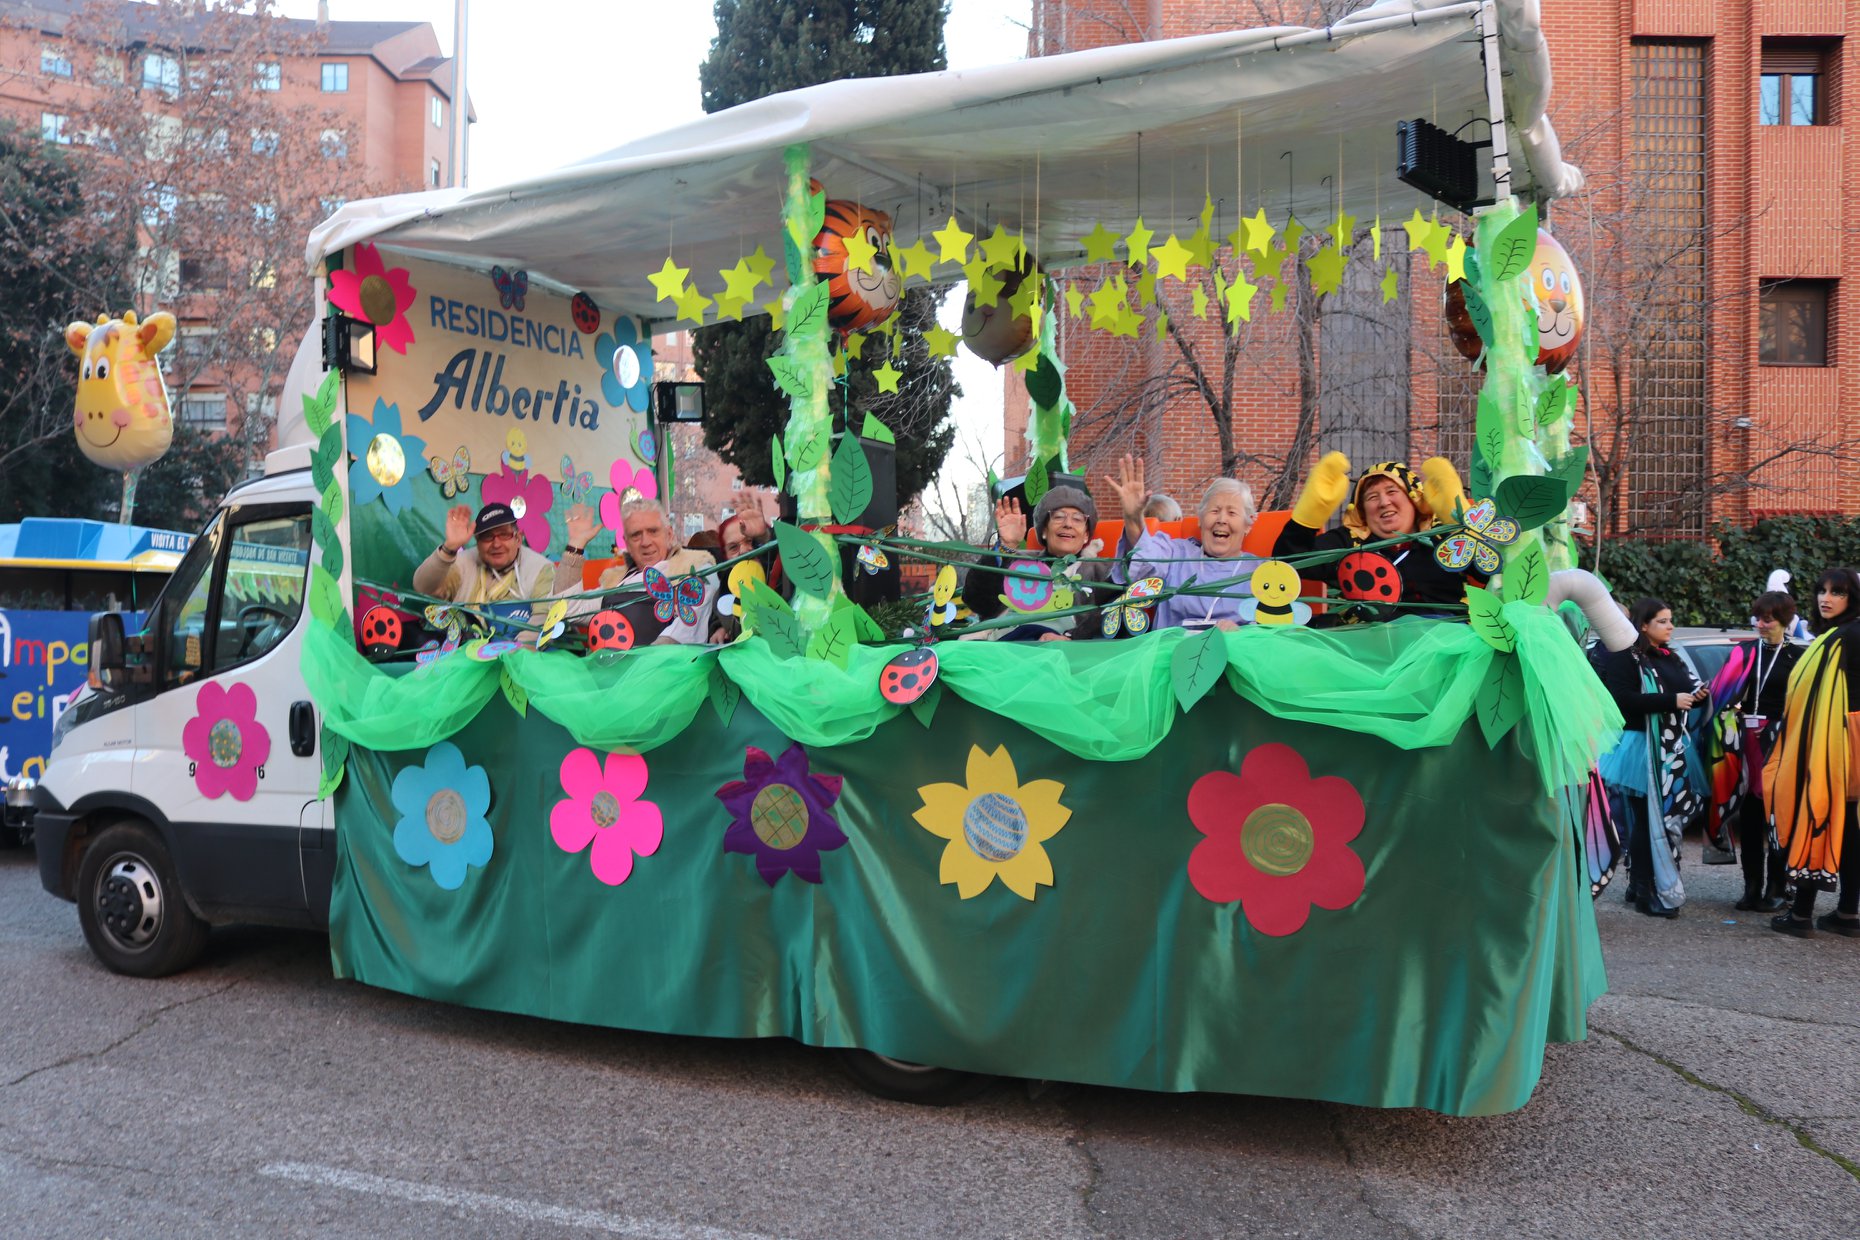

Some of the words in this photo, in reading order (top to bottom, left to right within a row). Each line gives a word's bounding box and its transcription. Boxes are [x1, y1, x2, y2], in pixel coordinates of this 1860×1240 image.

[430, 296, 584, 360] RESIDENCIA
[418, 348, 600, 431] Albertia
[151, 532, 175, 550] VISITA
[176, 536, 185, 551] EL
